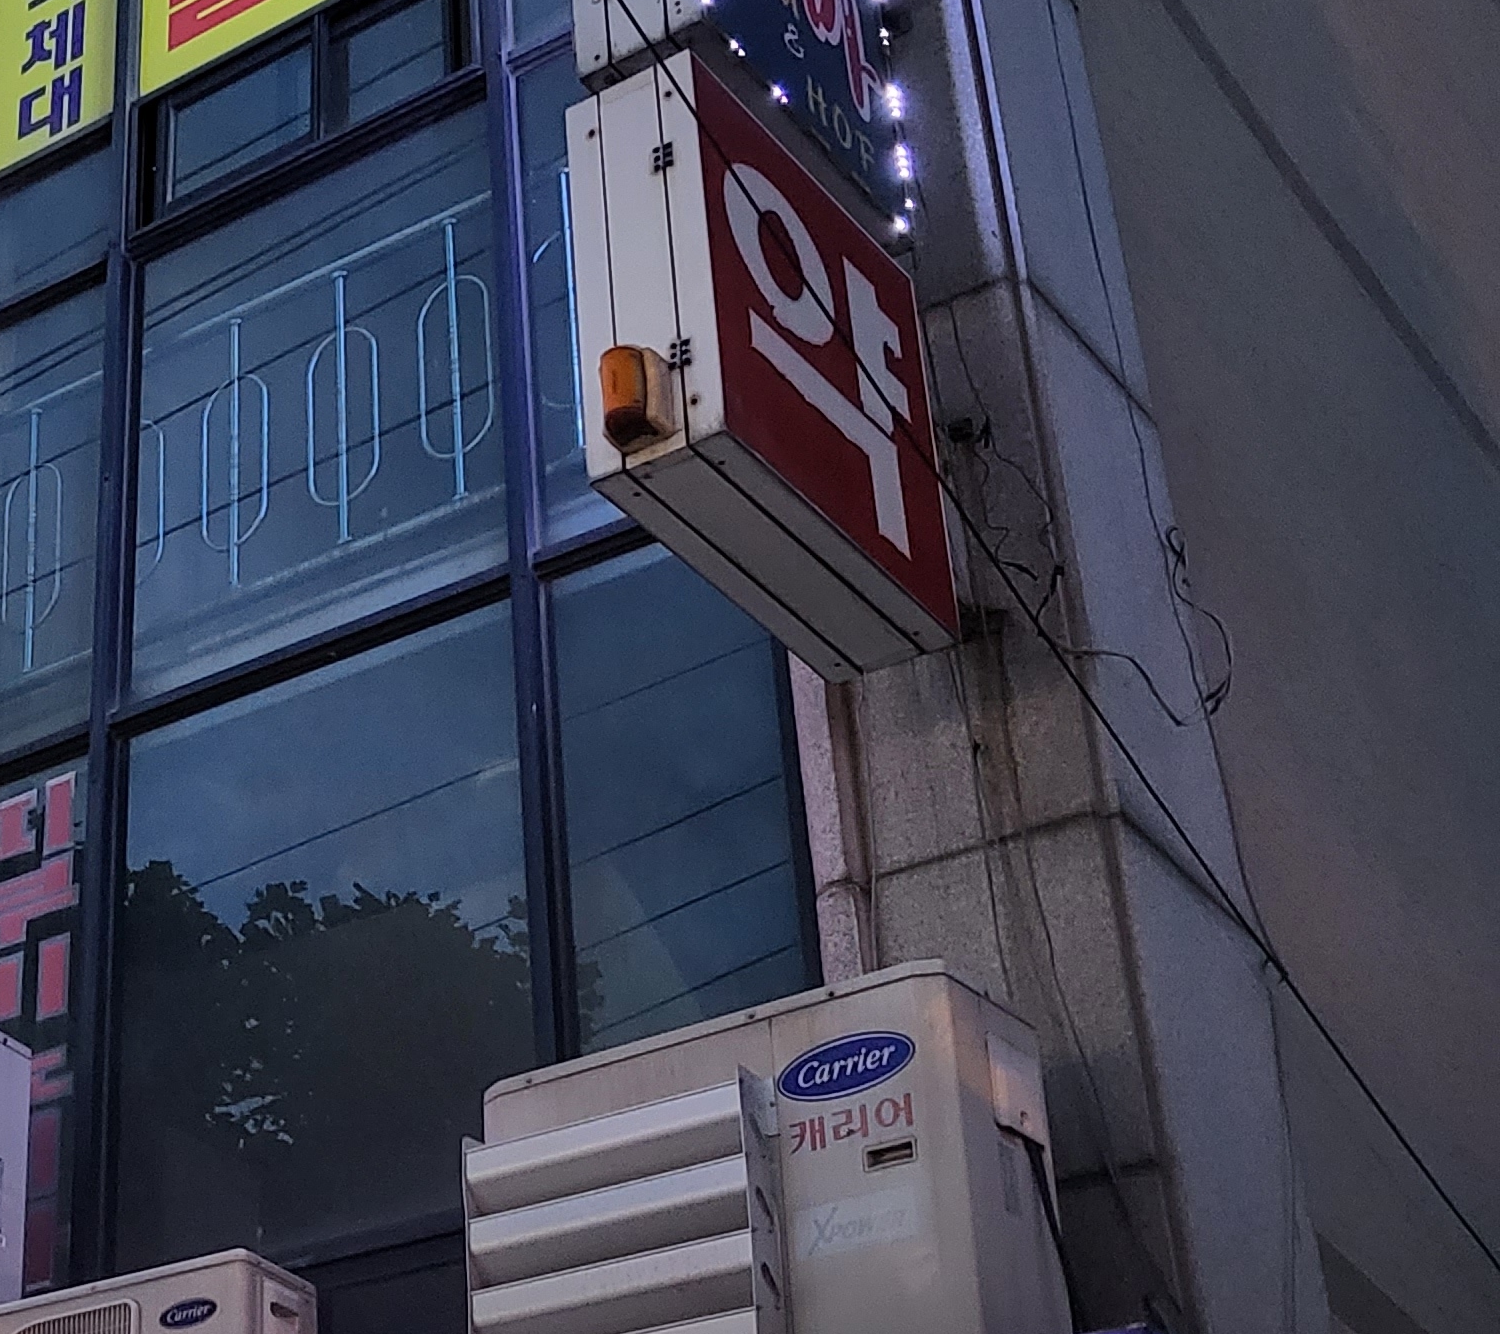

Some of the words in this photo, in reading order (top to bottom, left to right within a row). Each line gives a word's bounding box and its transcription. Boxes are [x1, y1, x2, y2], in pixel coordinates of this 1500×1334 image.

[805, 74, 876, 171] HOF
[723, 163, 911, 561] 약
[797, 1044, 896, 1089] Carrier
[788, 1092, 914, 1156] 캐리어
